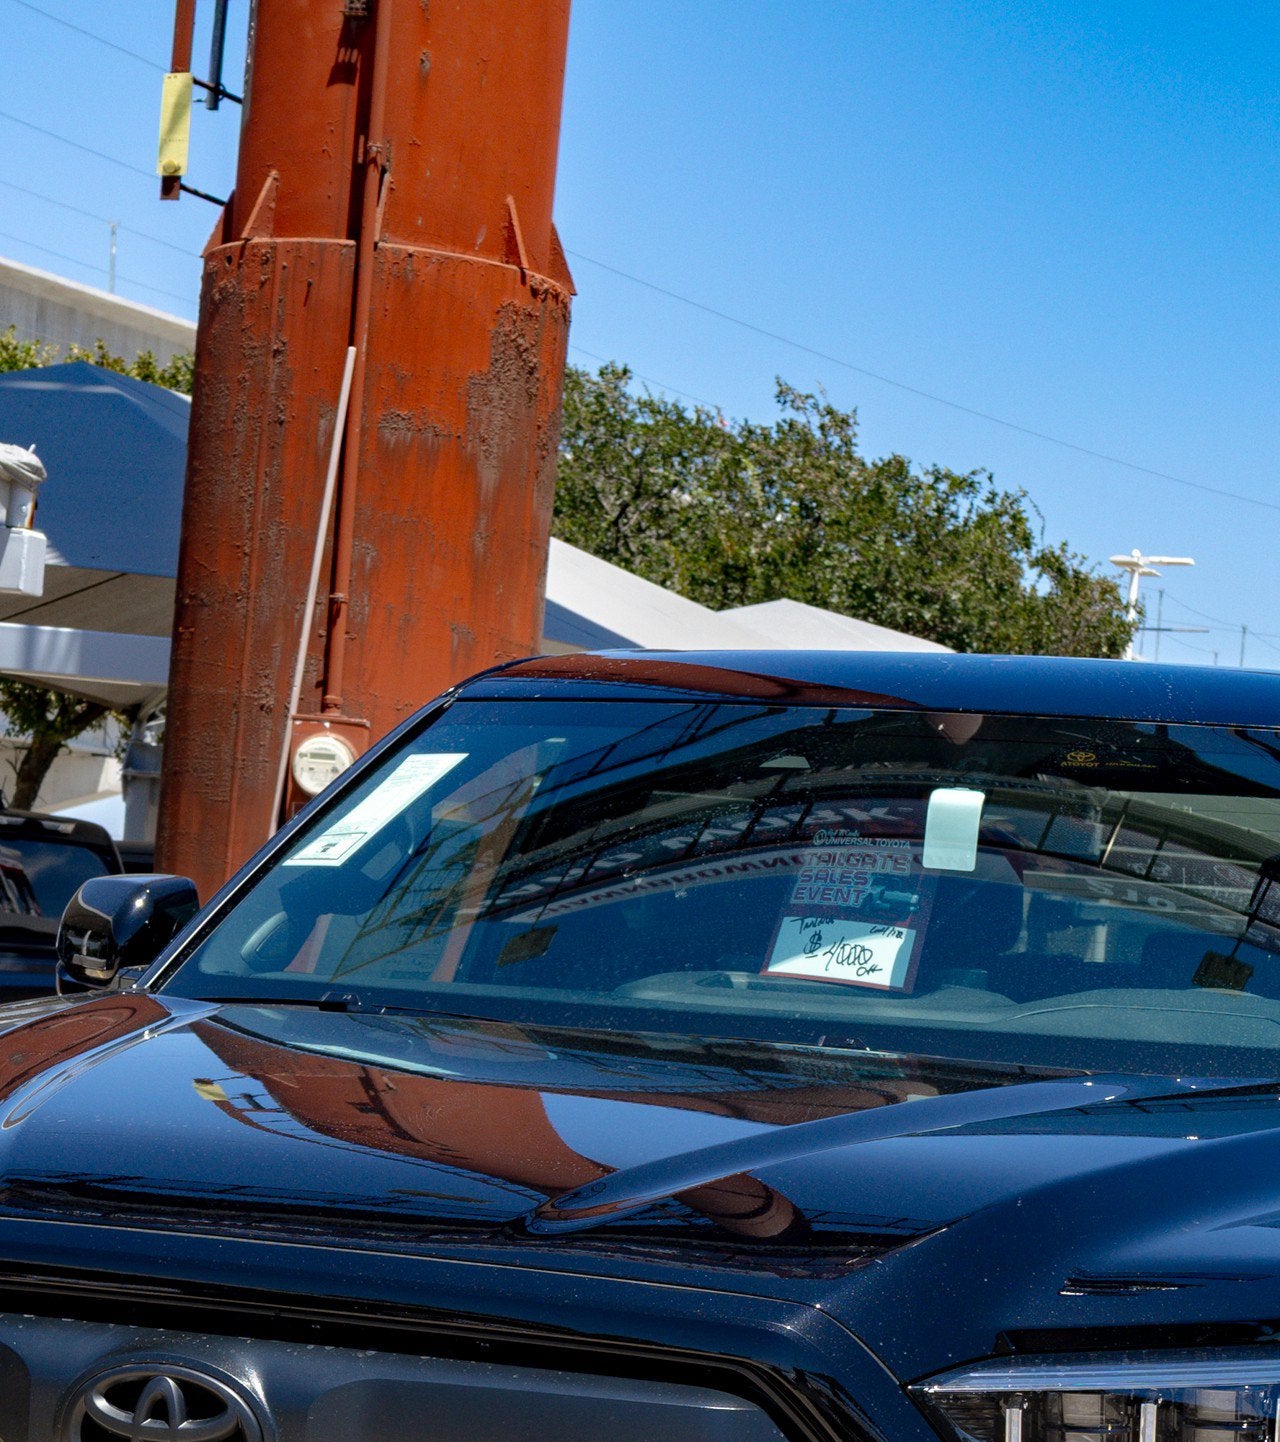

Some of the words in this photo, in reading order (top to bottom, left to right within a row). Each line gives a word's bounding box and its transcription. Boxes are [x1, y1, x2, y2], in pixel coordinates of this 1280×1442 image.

[825, 835, 873, 847] UNIVERSAL
[875, 838, 911, 849] TOYOTA
[807, 851, 910, 874] TAILGATE
[800, 868, 869, 887] SALES
[793, 886, 866, 904] EVENT
